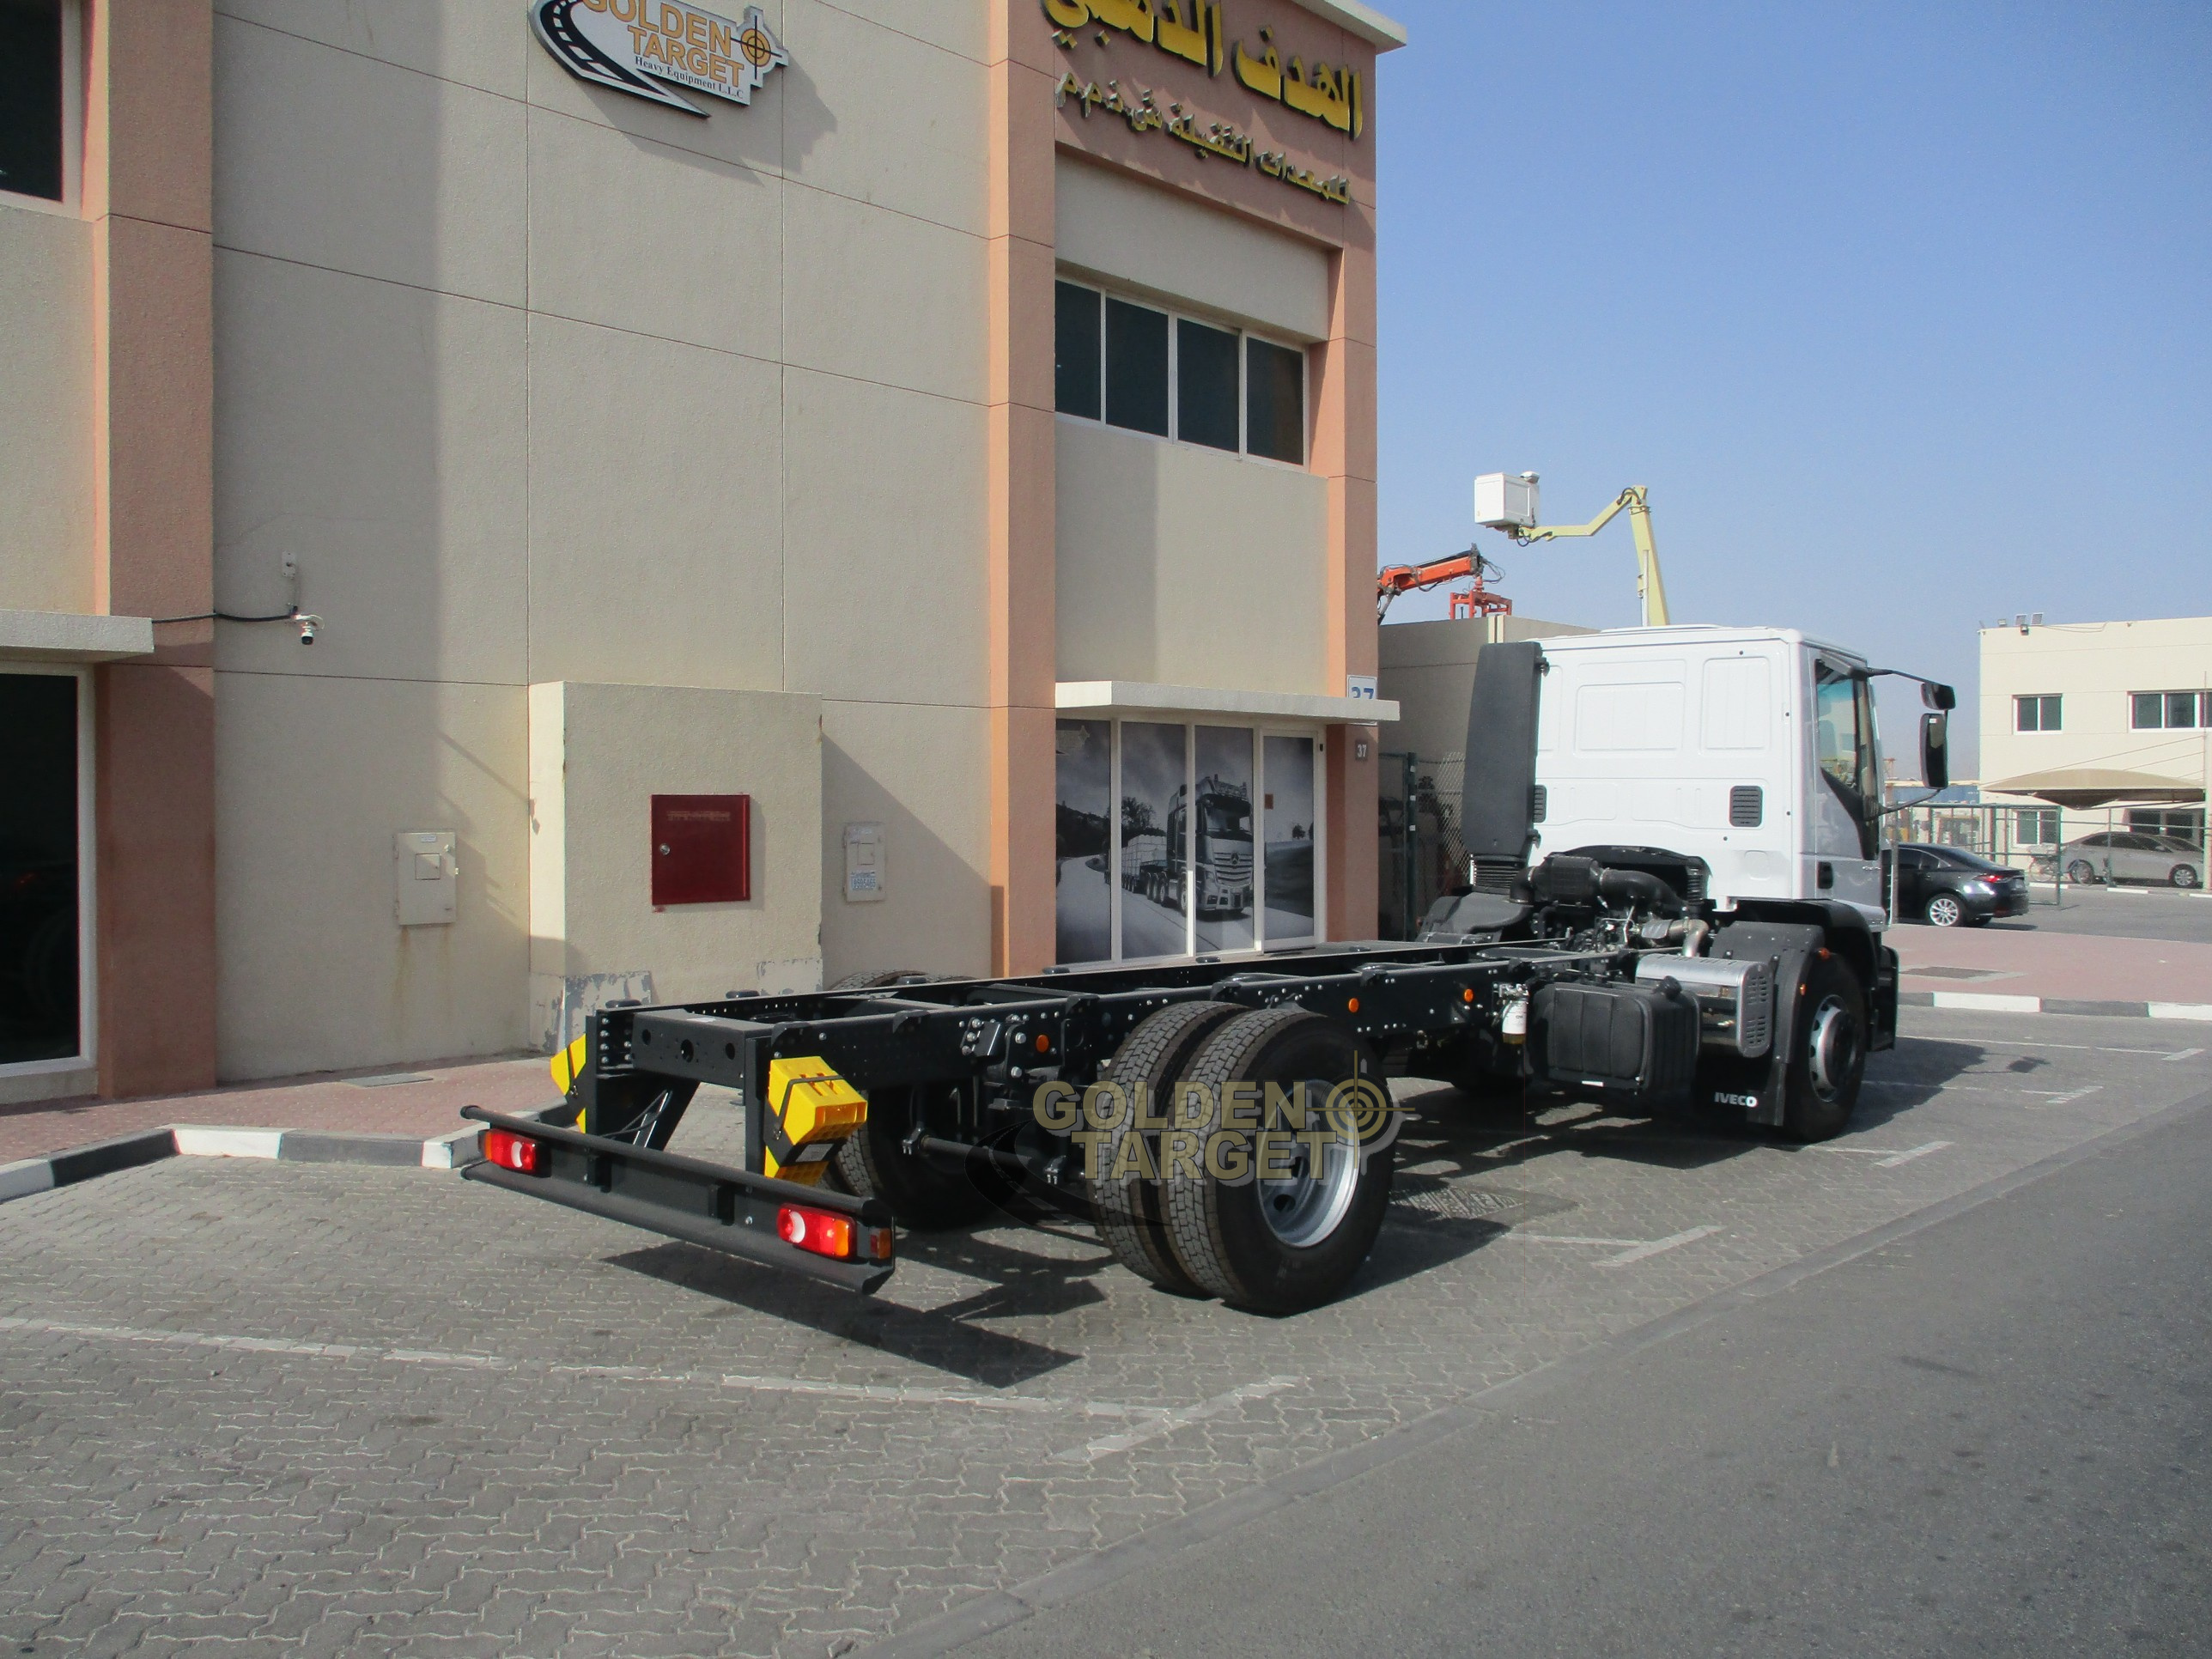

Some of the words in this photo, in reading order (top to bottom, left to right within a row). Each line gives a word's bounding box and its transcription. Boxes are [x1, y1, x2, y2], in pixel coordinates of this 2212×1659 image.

[628, 24, 744, 88] TARGET
[635, 56, 664, 74] Heavy
[667, 65, 715, 90] Equipment
[1233, 25, 1363, 140] الهدف
[1167, 103, 1254, 166] الثقيلة
[1357, 744, 1367, 757] 37
[1714, 1091, 1758, 1108] IVECO
